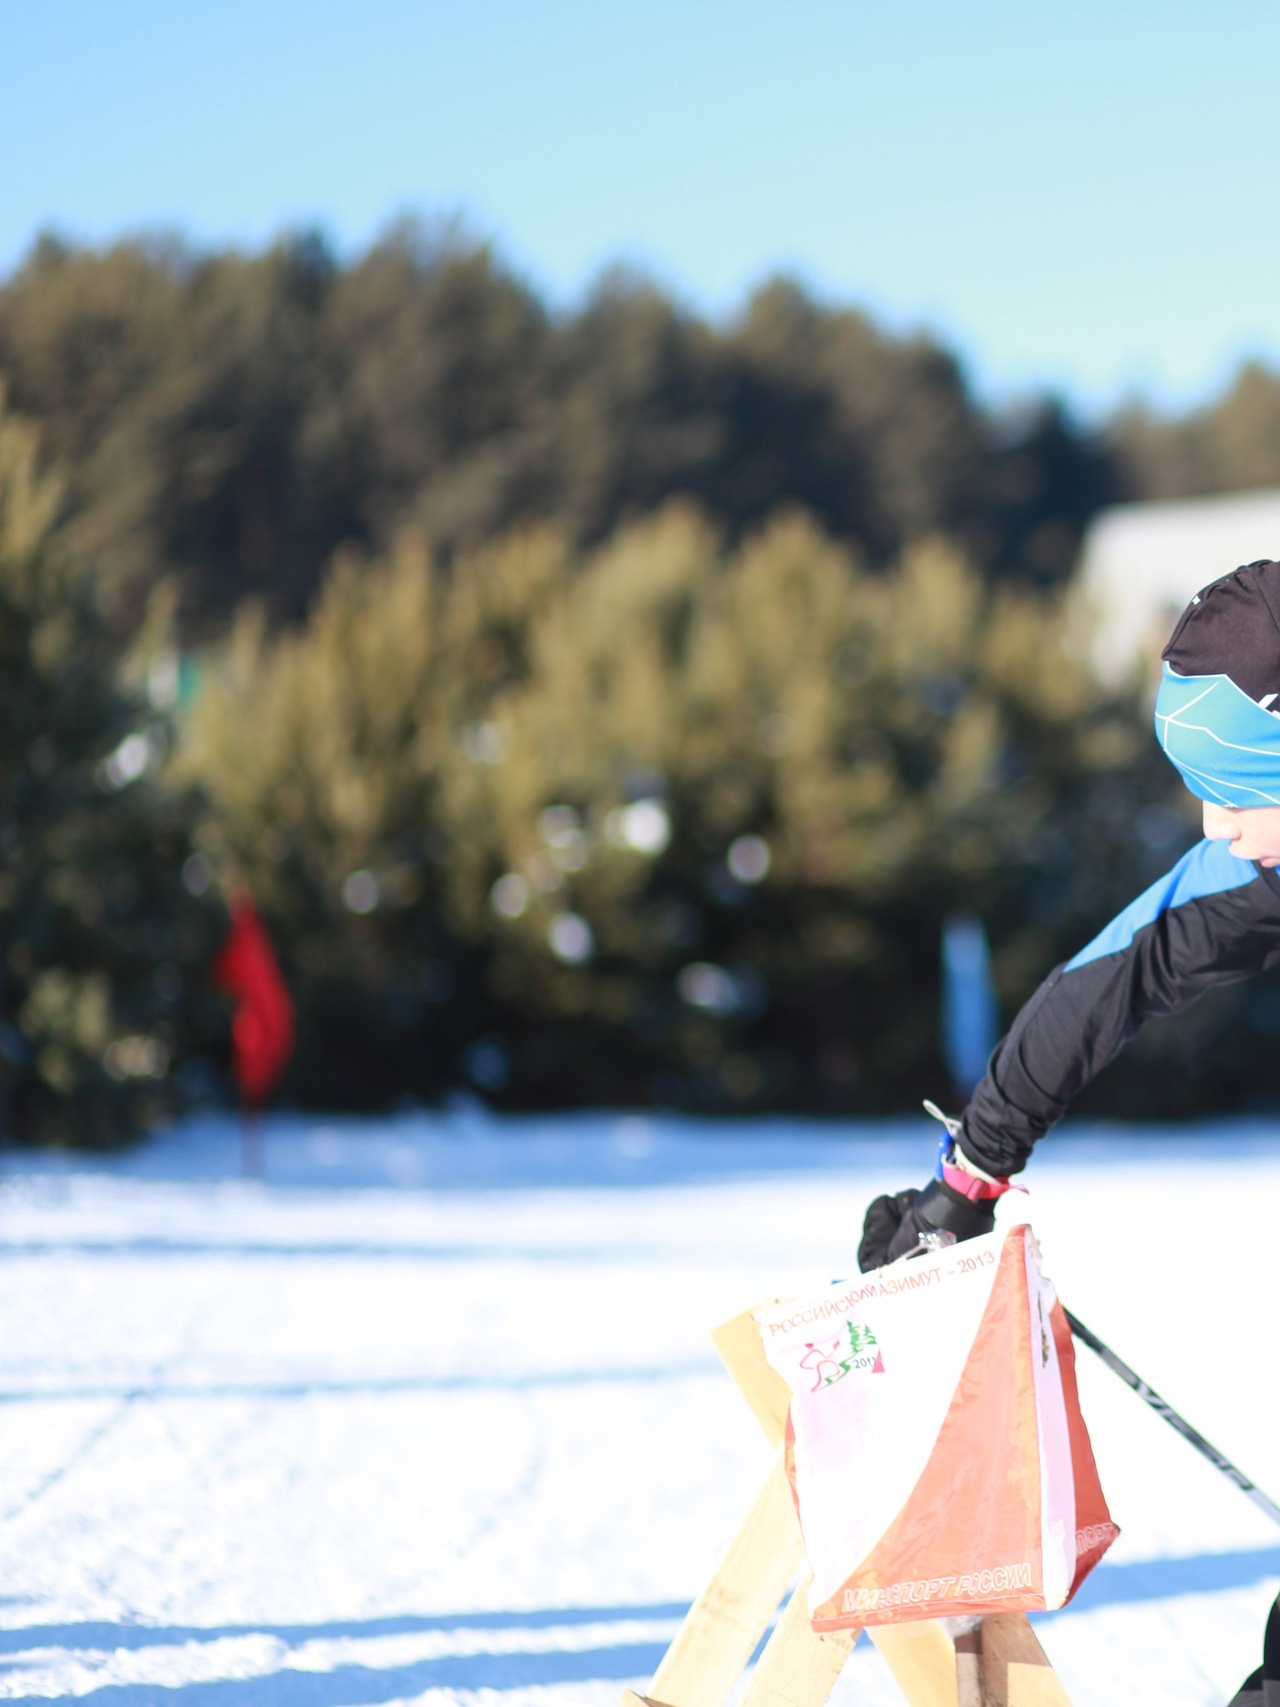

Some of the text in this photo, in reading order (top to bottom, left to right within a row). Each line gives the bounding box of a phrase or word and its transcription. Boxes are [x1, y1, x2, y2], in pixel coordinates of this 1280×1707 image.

[769, 1284, 878, 1336] РОССИЙСКИЙ
[879, 1267, 941, 1296] АЗИМУТ
[957, 1250, 996, 1274] 2013
[1075, 1521, 1115, 1555] ПОРТ
[952, 1562, 1032, 1598] РОССИИ
